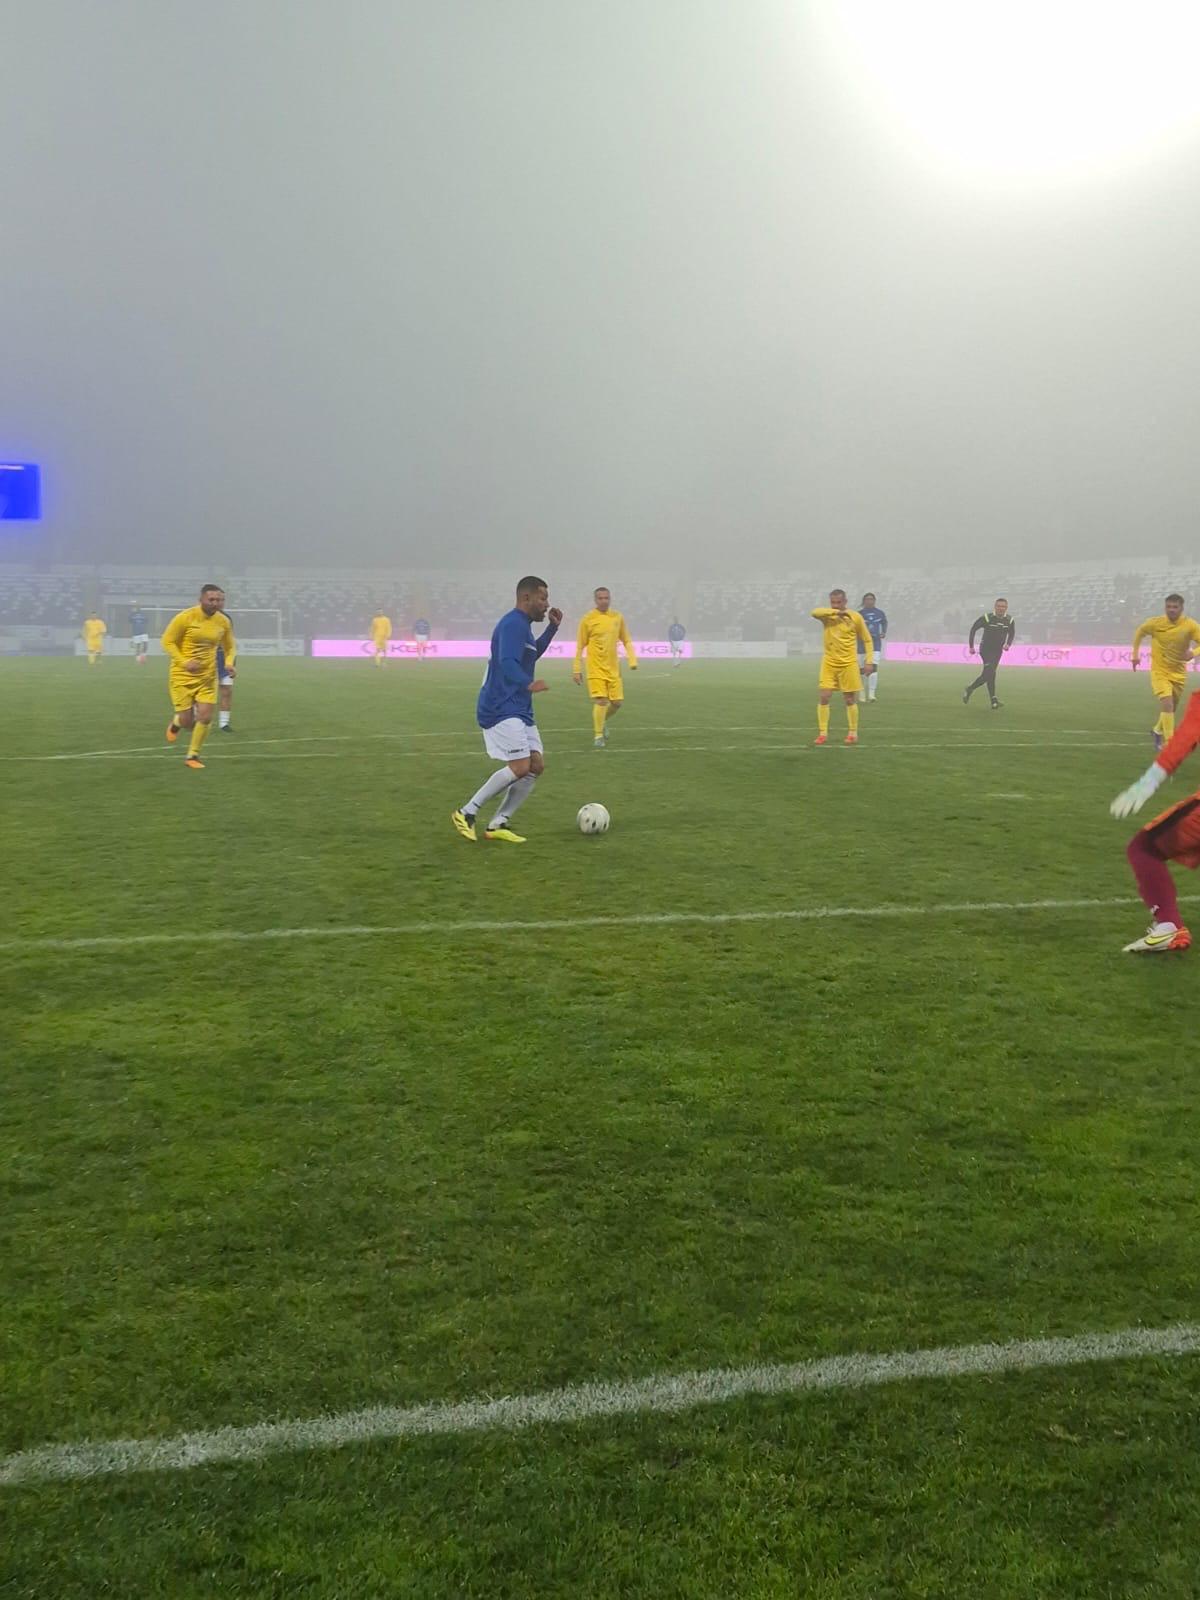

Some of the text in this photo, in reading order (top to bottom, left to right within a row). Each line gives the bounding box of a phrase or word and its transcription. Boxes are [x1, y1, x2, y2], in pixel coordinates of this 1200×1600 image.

[640, 645, 683, 654] KG
[1042, 650, 1070, 661] KGM
[1119, 651, 1151, 662] KM
